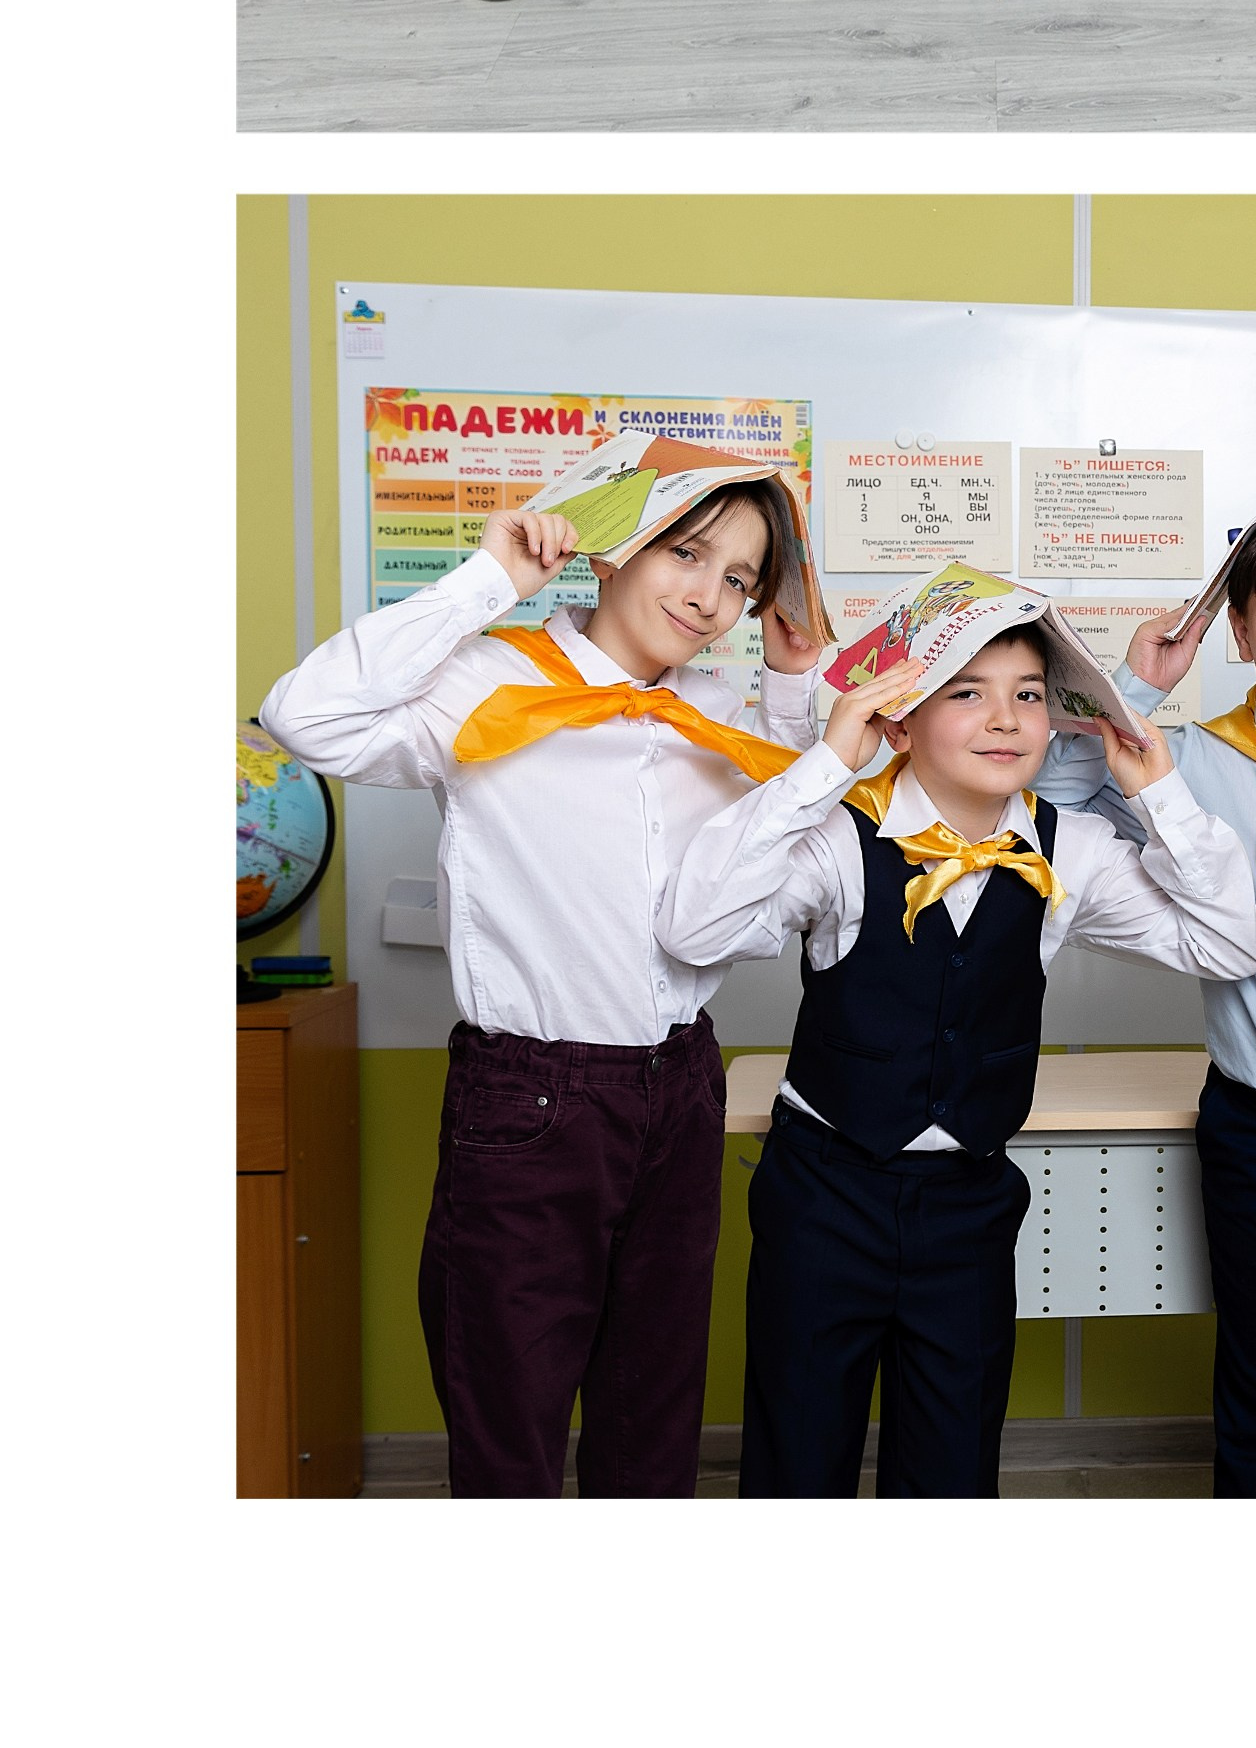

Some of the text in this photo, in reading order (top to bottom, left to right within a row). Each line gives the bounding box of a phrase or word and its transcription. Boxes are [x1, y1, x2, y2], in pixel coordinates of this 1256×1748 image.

[403, 404, 783, 438] ПАДЕЖИ И СКЛОНЕНИЯ ИМЁН
[619, 426, 783, 442] ЩЕСТВИТЕЛЬНЫХ
[376, 446, 449, 465] ПАДЕЖ
[708, 445, 790, 457] ОКОНЧАНИЯ
[849, 454, 984, 467] МЕСТОИМЕНИЕ
[1087, 460, 1171, 472] ПИШЕТСЯ:
[459, 467, 502, 476] ВОПРОС
[508, 469, 543, 477] СЛОВО
[846, 478, 995, 489] ЛИЦО ЕД.Ч. МН.Ч.
[1034, 480, 1058, 488] (дочь,
[466, 486, 496, 495] КТО?
[375, 490, 455, 502] ИМЕНИТЕЛЬНЫЙ
[861, 492, 989, 502] 1 Я МЫ
[466, 500, 496, 509] ЧТО?
[860, 503, 988, 512] 2 ТЫ ВЫ
[1034, 505, 1115, 514] (рисуешь, гуляешь)
[860, 513, 991, 525] 3 ОН, ОНА, ОНИ
[1052, 513, 1120, 522] неопределенной
[1122, 514, 1150, 522] форме
[462, 521, 483, 530] КОГ
[914, 525, 941, 535] ОНО
[1062, 521, 1095, 529] беречь)
[377, 526, 454, 537] РОДИТЕЛЬНЫЙ
[1075, 533, 1096, 544] НЕ
[1101, 534, 1185, 545] ПИШЕТСЯ:
[384, 560, 448, 570] ДАТЕЛЬНЫЙ
[845, 598, 880, 608] СПРЯ
[1056, 606, 1168, 616] ЯЖЕНИЕ ГЛАГОЛОВ
[1073, 626, 1109, 634] жение
[920, 607, 980, 665] ЧТЕНИ
[845, 646, 879, 687] 4
